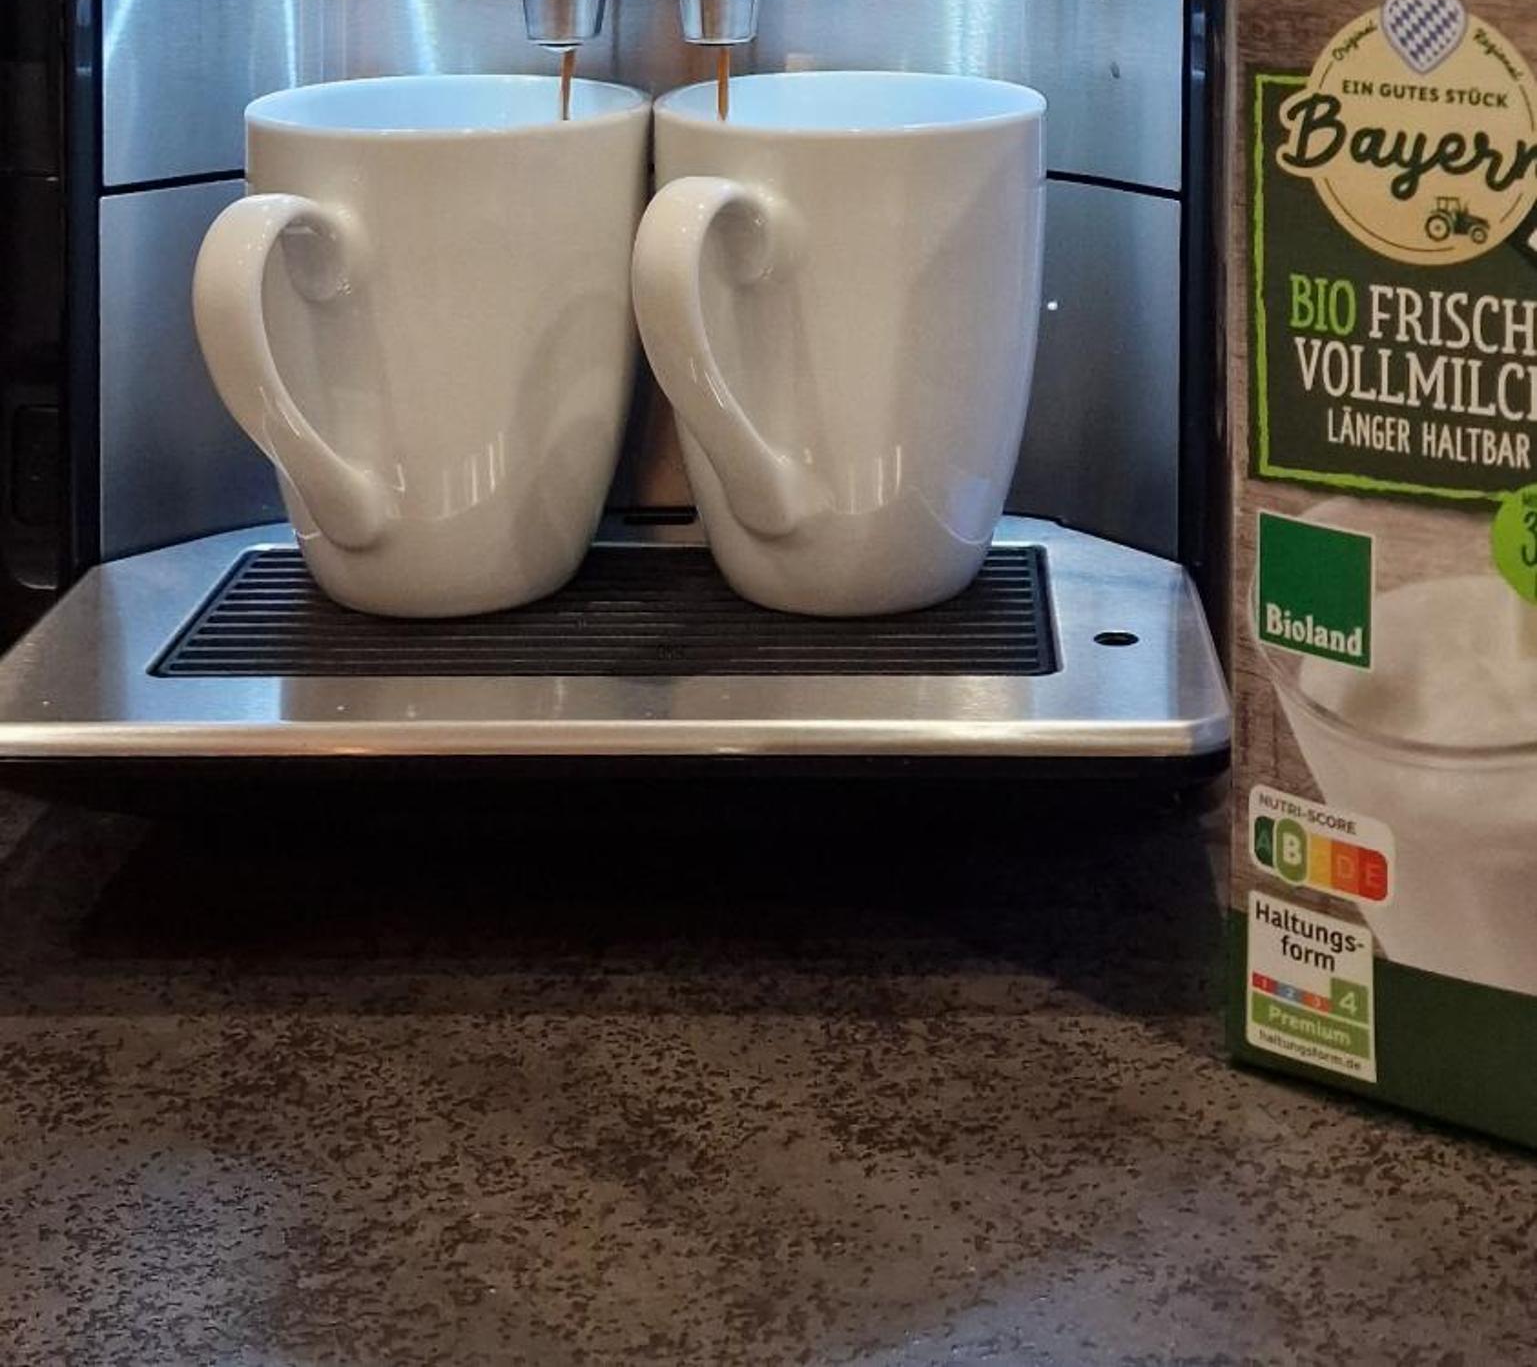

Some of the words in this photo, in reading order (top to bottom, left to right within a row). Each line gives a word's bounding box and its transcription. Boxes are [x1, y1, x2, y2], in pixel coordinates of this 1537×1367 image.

[1342, 80, 1373, 96] EIN
[1379, 87, 1440, 103] GUTES
[1445, 89, 1508, 109] STÜCK
[1289, 274, 1357, 336] BIO
[1368, 284, 1537, 357] FRISCH
[1327, 406, 1410, 454] LÄNGER
[1421, 421, 1531, 469] HALTBAR
[1265, 603, 1363, 657] Bioland
[1259, 793, 1357, 836] NUTRI-SCORE
[1282, 832, 1301, 866] B
[1256, 901, 1364, 954] Haltungs-
[1281, 935, 1336, 972] form
[1268, 1005, 1352, 1046] Premium
[1338, 992, 1358, 1017] 4
